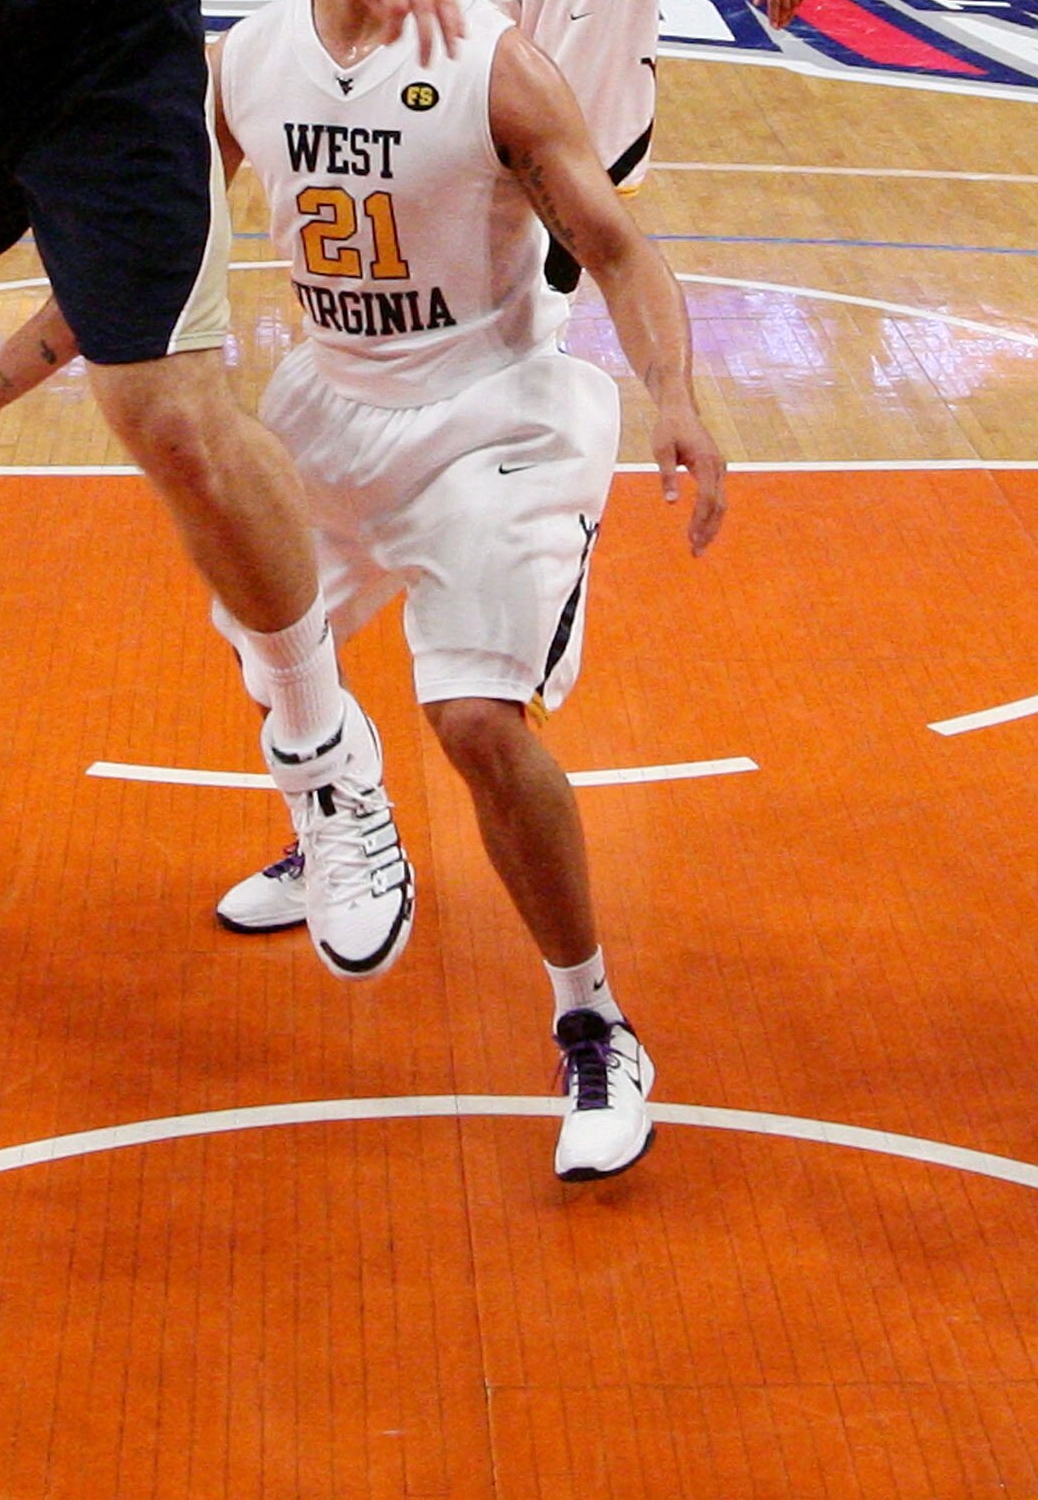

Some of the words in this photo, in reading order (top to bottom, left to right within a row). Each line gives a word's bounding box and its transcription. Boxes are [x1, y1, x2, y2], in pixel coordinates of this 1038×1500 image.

[407, 86, 433, 106] FS
[284, 123, 402, 179] WEST
[296, 186, 410, 280] 21
